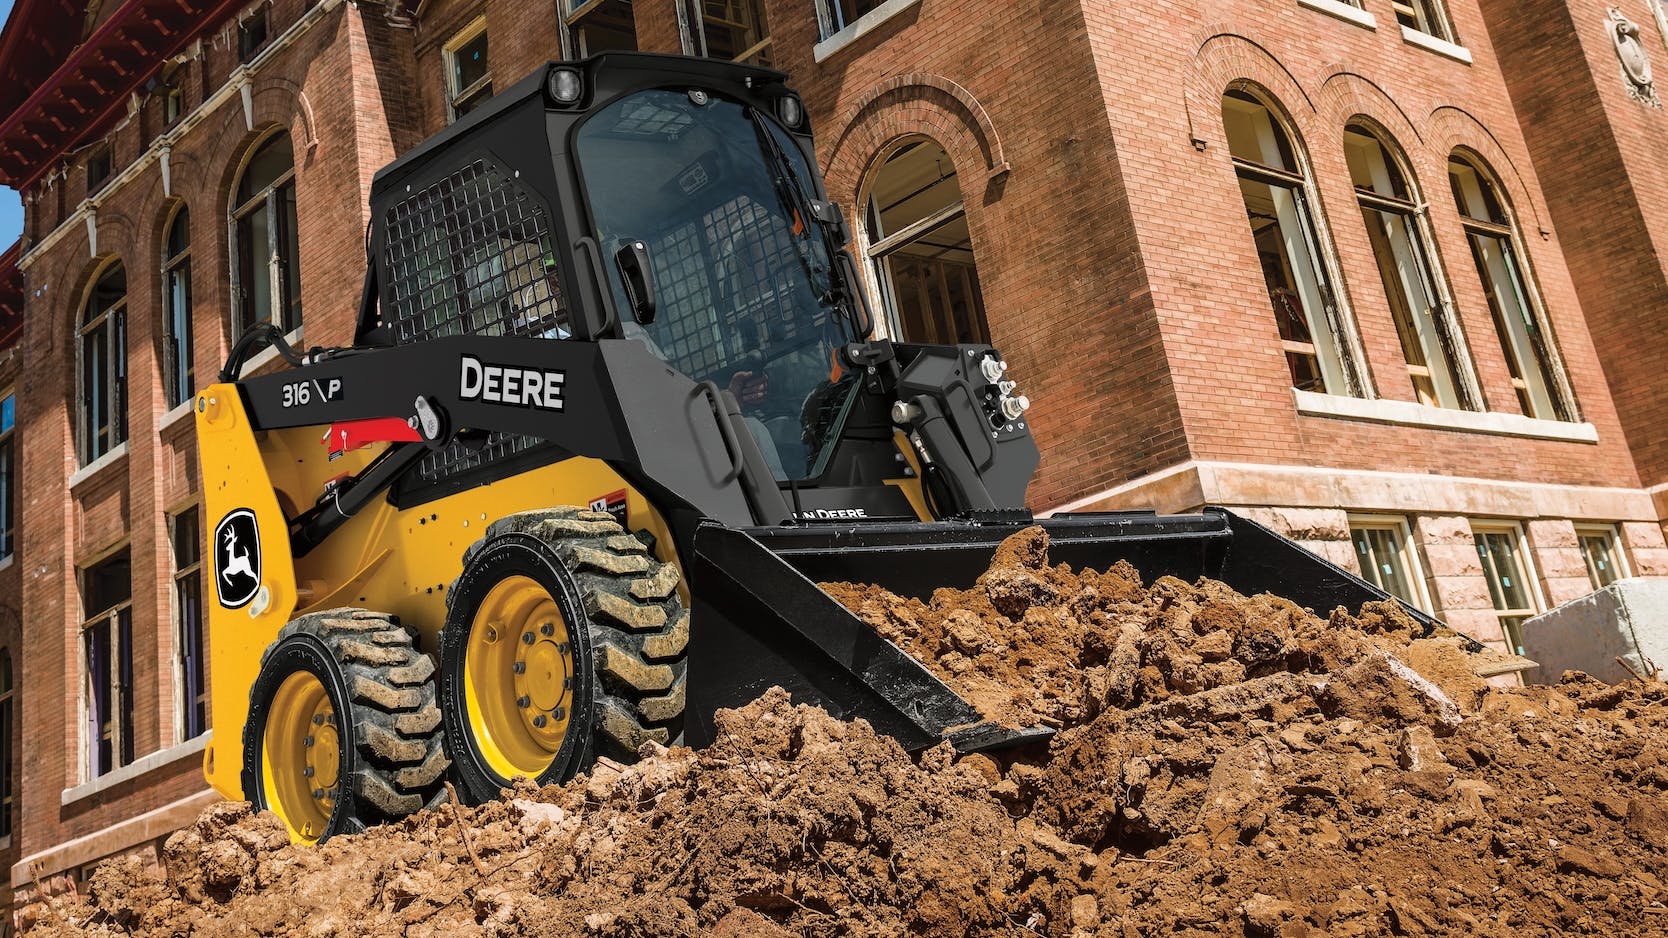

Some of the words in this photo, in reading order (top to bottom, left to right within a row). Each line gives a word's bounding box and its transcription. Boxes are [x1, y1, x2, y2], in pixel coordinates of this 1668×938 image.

[282, 381, 310, 408] 316
[460, 357, 564, 408] DEERE
[815, 508, 867, 519] DEERE
